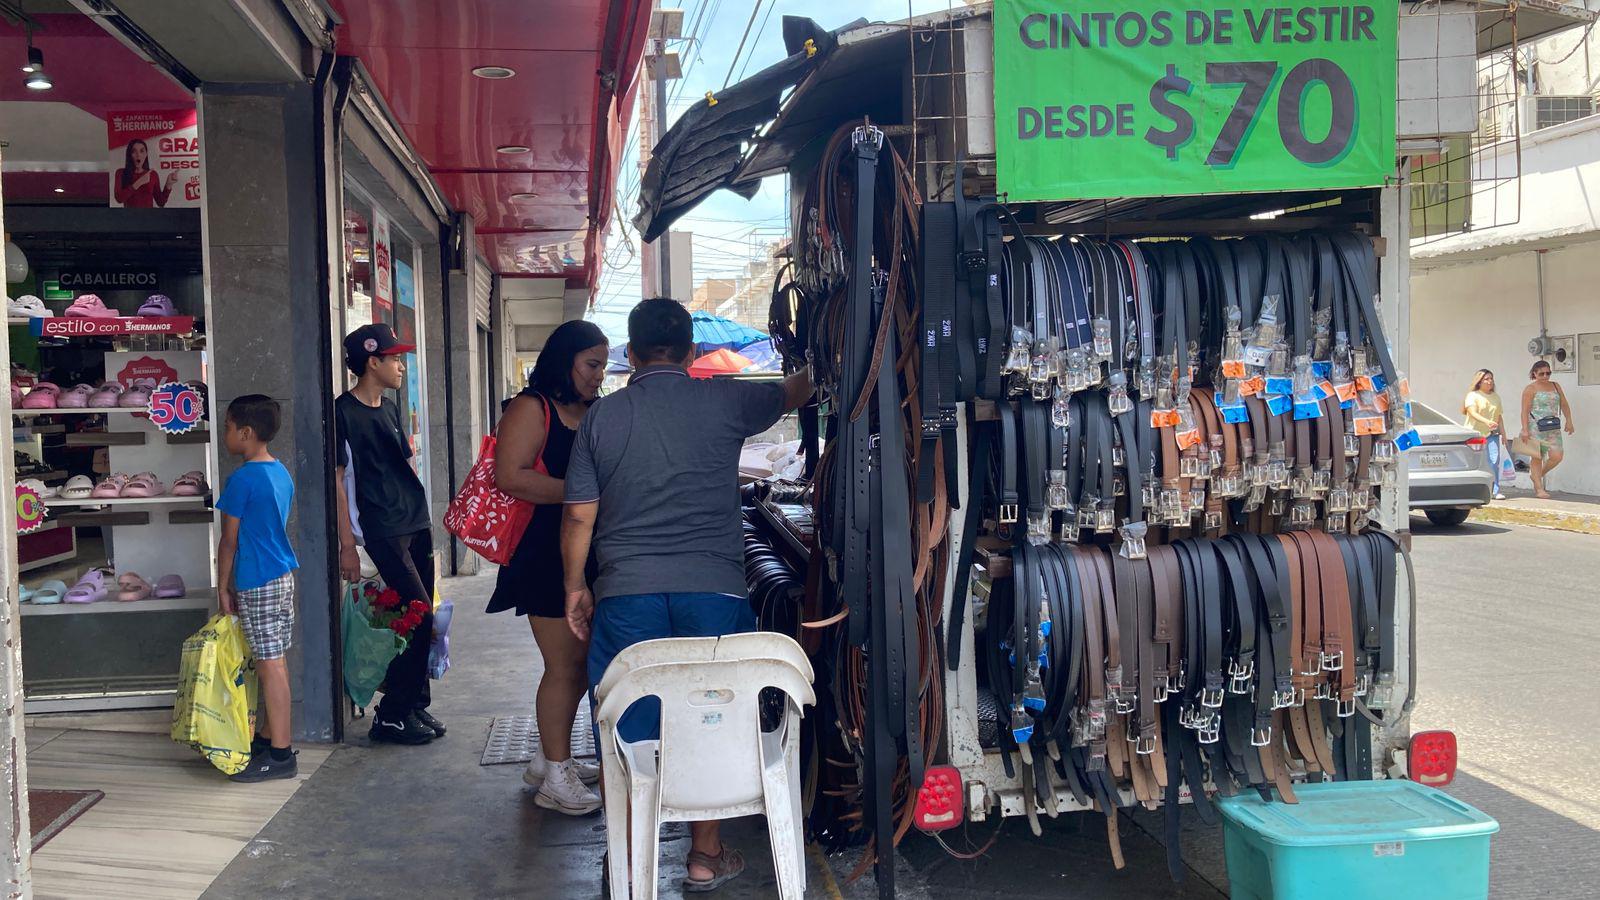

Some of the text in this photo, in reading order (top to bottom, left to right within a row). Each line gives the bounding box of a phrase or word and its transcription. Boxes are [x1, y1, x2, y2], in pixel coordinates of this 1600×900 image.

[1019, 5, 1378, 49] CINTOS DE VESTIR
[1017, 57, 1360, 171] DESDE $70
[160, 160, 199, 170] DESC
[60, 272, 158, 286] CABALLEROS
[46, 319, 96, 333] estilo
[99, 323, 120, 332] con
[151, 390, 203, 425] 50%
[463, 535, 487, 547] Aurrera
